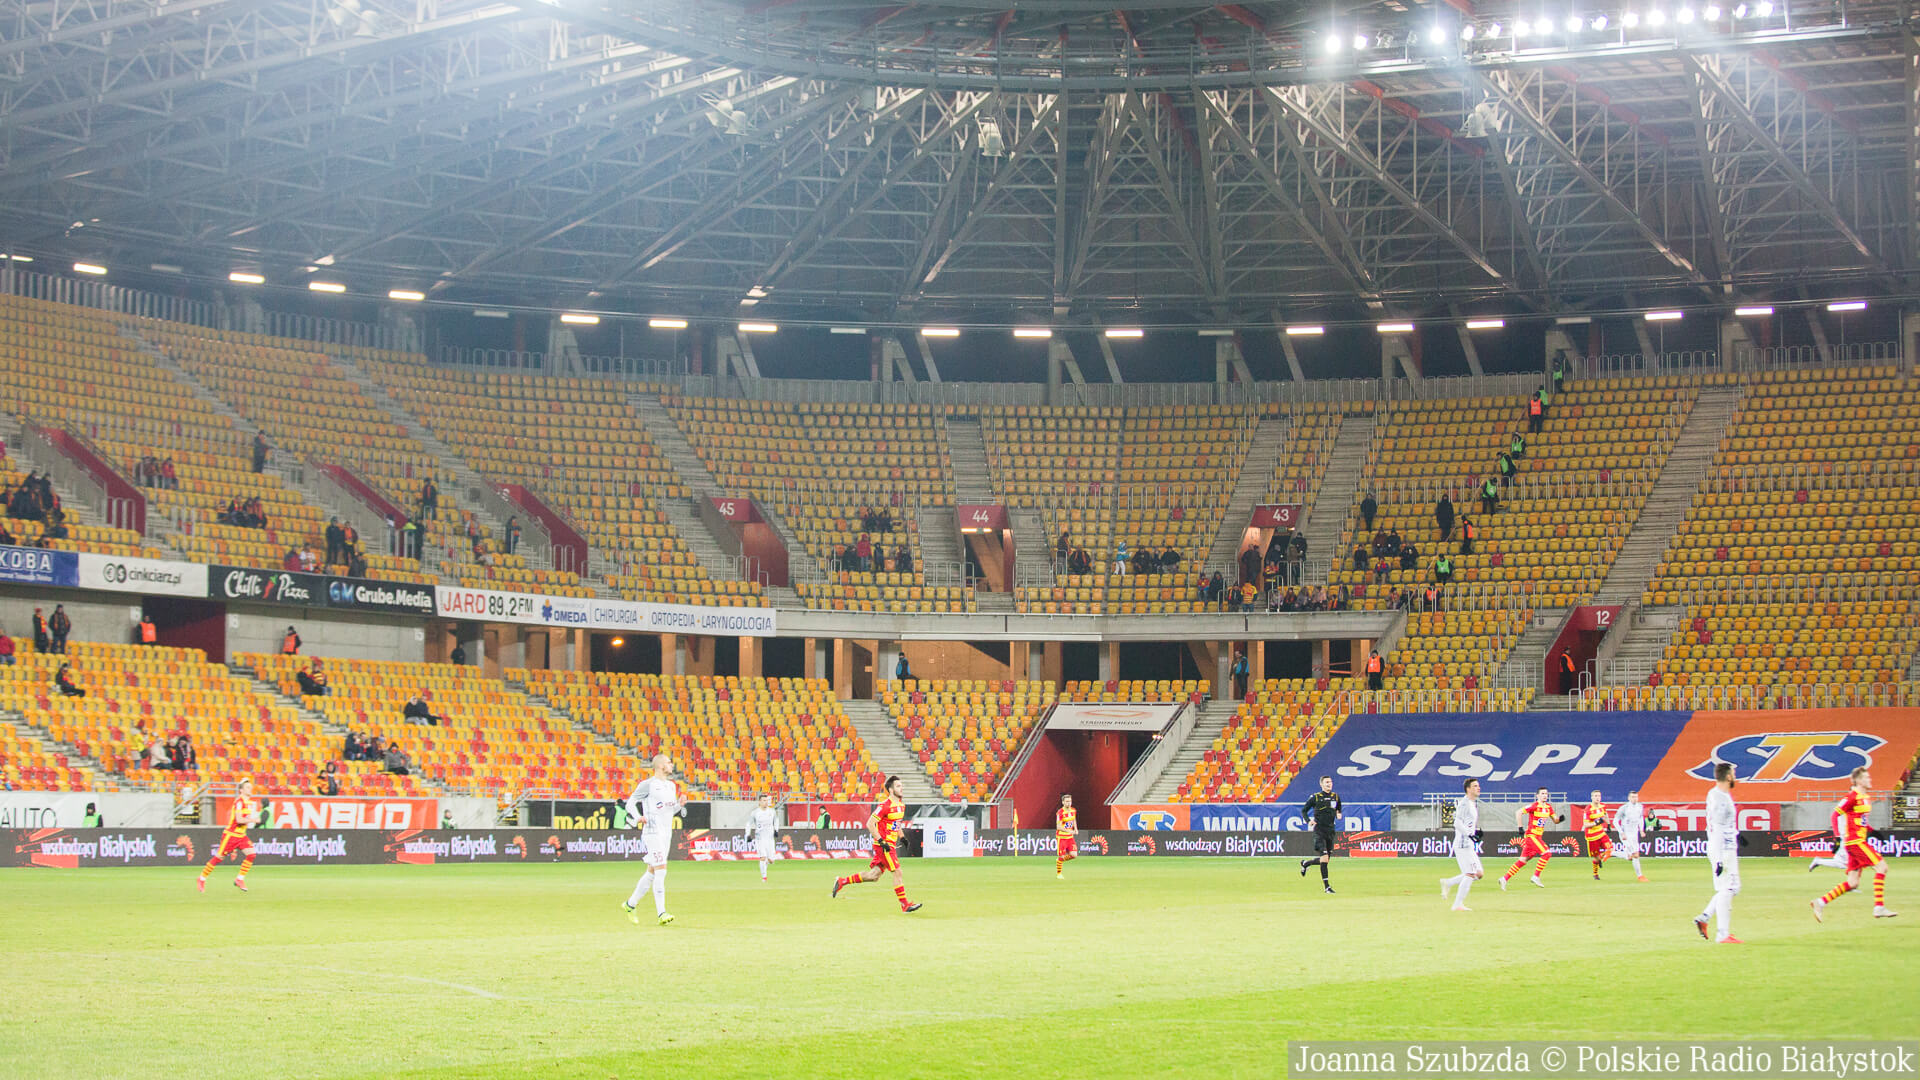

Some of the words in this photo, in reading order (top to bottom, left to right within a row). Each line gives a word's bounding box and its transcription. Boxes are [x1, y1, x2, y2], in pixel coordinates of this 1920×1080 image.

[719, 502, 735, 516] 45
[972, 509, 989, 523] 44
[1273, 508, 1289, 522] 43
[277, 573, 311, 600] Pizza
[329, 581, 354, 603] GM
[356, 586, 432, 608] Grube.Media
[519, 598, 533, 613] FM
[554, 610, 588, 623] OMEDA
[594, 607, 638, 624] CHIRURGIA
[651, 611, 696, 628] ORTOPEDIA
[701, 614, 772, 632] LARYNGOLOGIA
[1596, 610, 1610, 624] 12
[1337, 744, 1618, 781] STS.PL
[1685, 731, 1888, 783] STS
[100, 834, 156, 863] Białystok
[253, 837, 295, 858] schodzący
[296, 834, 347, 861] Białystok
[451, 834, 496, 860] Białystok
[1007, 834, 1057, 855] Białysto
[1165, 838, 1222, 854] wschodzący
[1225, 834, 1285, 857] Białystok
[1360, 838, 1418, 853] wschodzący
[1655, 835, 1708, 857] Białysto
